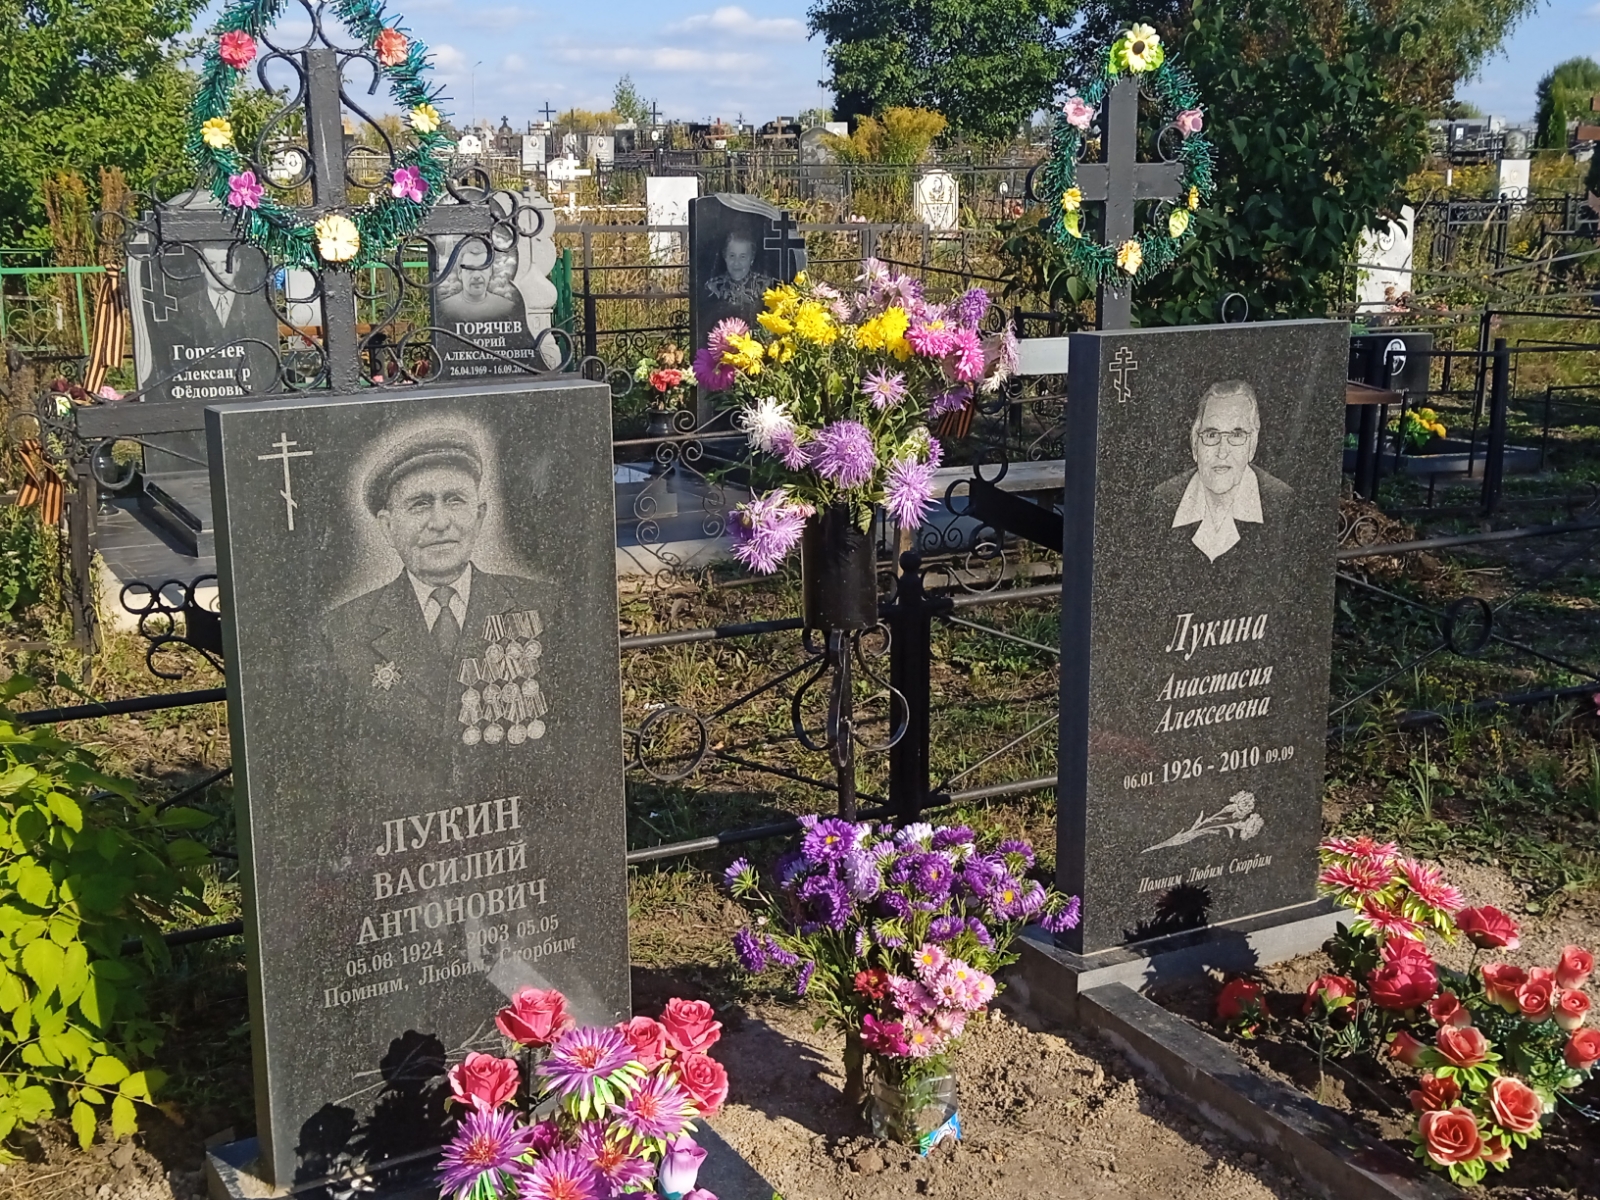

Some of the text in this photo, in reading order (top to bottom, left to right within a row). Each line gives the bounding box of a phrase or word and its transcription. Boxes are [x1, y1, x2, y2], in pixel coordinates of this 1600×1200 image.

[455, 321, 522, 335] ГОРЯЧЕВ
[473, 336, 506, 347] ЮРИЙ
[172, 368, 251, 382] Алексанр
[450, 366, 487, 376] 26.04.1969
[494, 365, 529, 375] 16.09.20
[1166, 613, 1268, 660] Лукина
[1156, 666, 1273, 701] Анастасия
[1154, 696, 1271, 734] Алексеевна
[1123, 771, 1153, 790] 06.01
[1162, 757, 1202, 783] 1926
[1220, 746, 1260, 773] 2010
[1265, 745, 1294, 764] 09.09
[376, 796, 521, 856] ЛУКИН
[373, 839, 528, 900] ВАСИЛИЙ
[1138, 853, 1271, 893] Помним Любим Скорбим
[356, 878, 548, 945] АНТОНОВИЧ
[346, 952, 393, 977] 05.08
[401, 939, 443, 966] 1924
[467, 924, 509, 949] 2003
[517, 914, 559, 938] 05.05
[323, 936, 576, 1009] Помним, Любим, Скорбим
